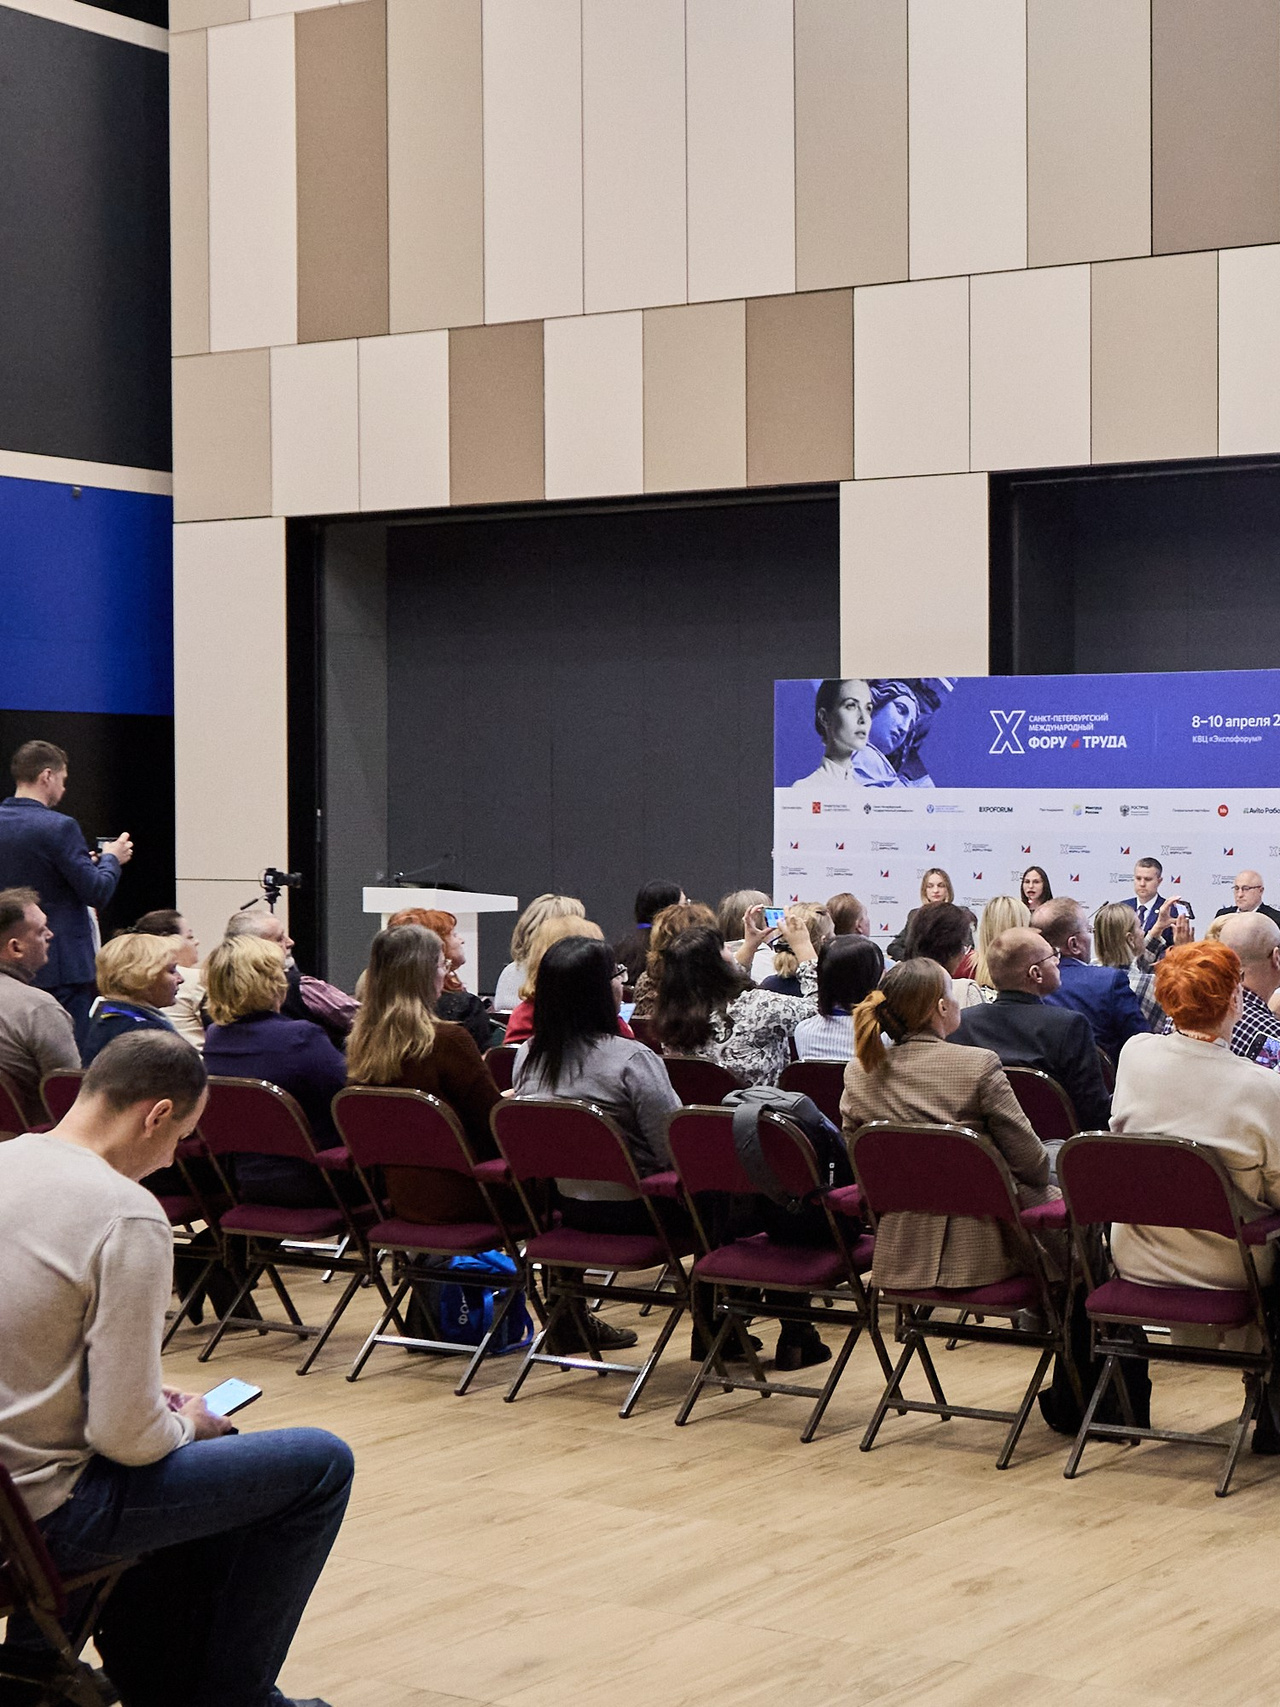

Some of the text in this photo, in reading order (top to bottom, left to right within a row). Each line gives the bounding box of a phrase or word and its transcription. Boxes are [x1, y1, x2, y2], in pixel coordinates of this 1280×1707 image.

[1028, 712, 1109, 723] САНКТ-ПЕТЕРБУРГСКИЙ
[1225, 717, 1271, 730] апреля
[1028, 722, 1094, 732] МЕЖДУНАРОДНЫЙ
[1082, 735, 1127, 749] ТРУДА
